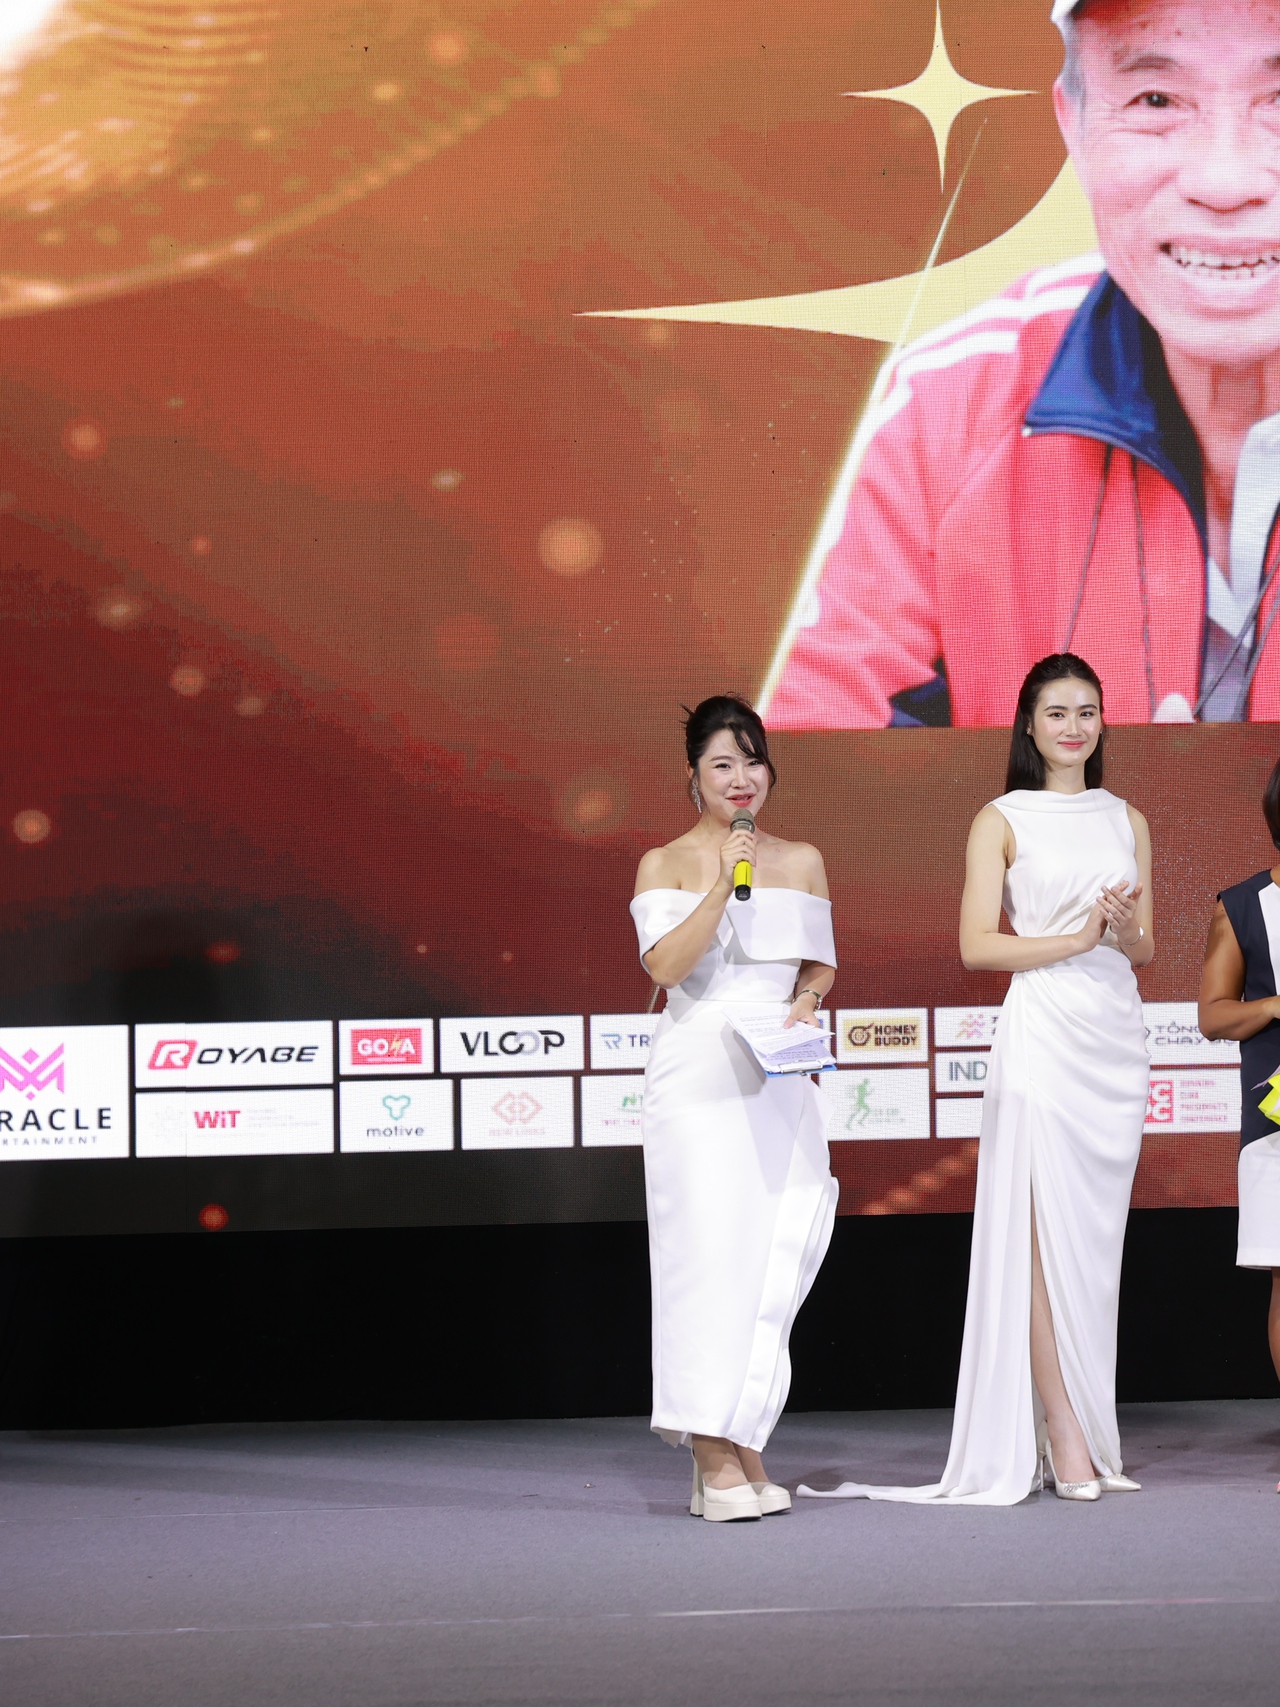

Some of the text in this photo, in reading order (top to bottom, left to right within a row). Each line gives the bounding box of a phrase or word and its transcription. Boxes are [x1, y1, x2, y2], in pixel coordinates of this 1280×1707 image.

[875, 1024, 917, 1035] HONEY
[628, 1034, 654, 1048] TR
[875, 1036, 917, 1046] BUDDY
[194, 1110, 241, 1128] WiT
[366, 1125, 425, 1137] motive
